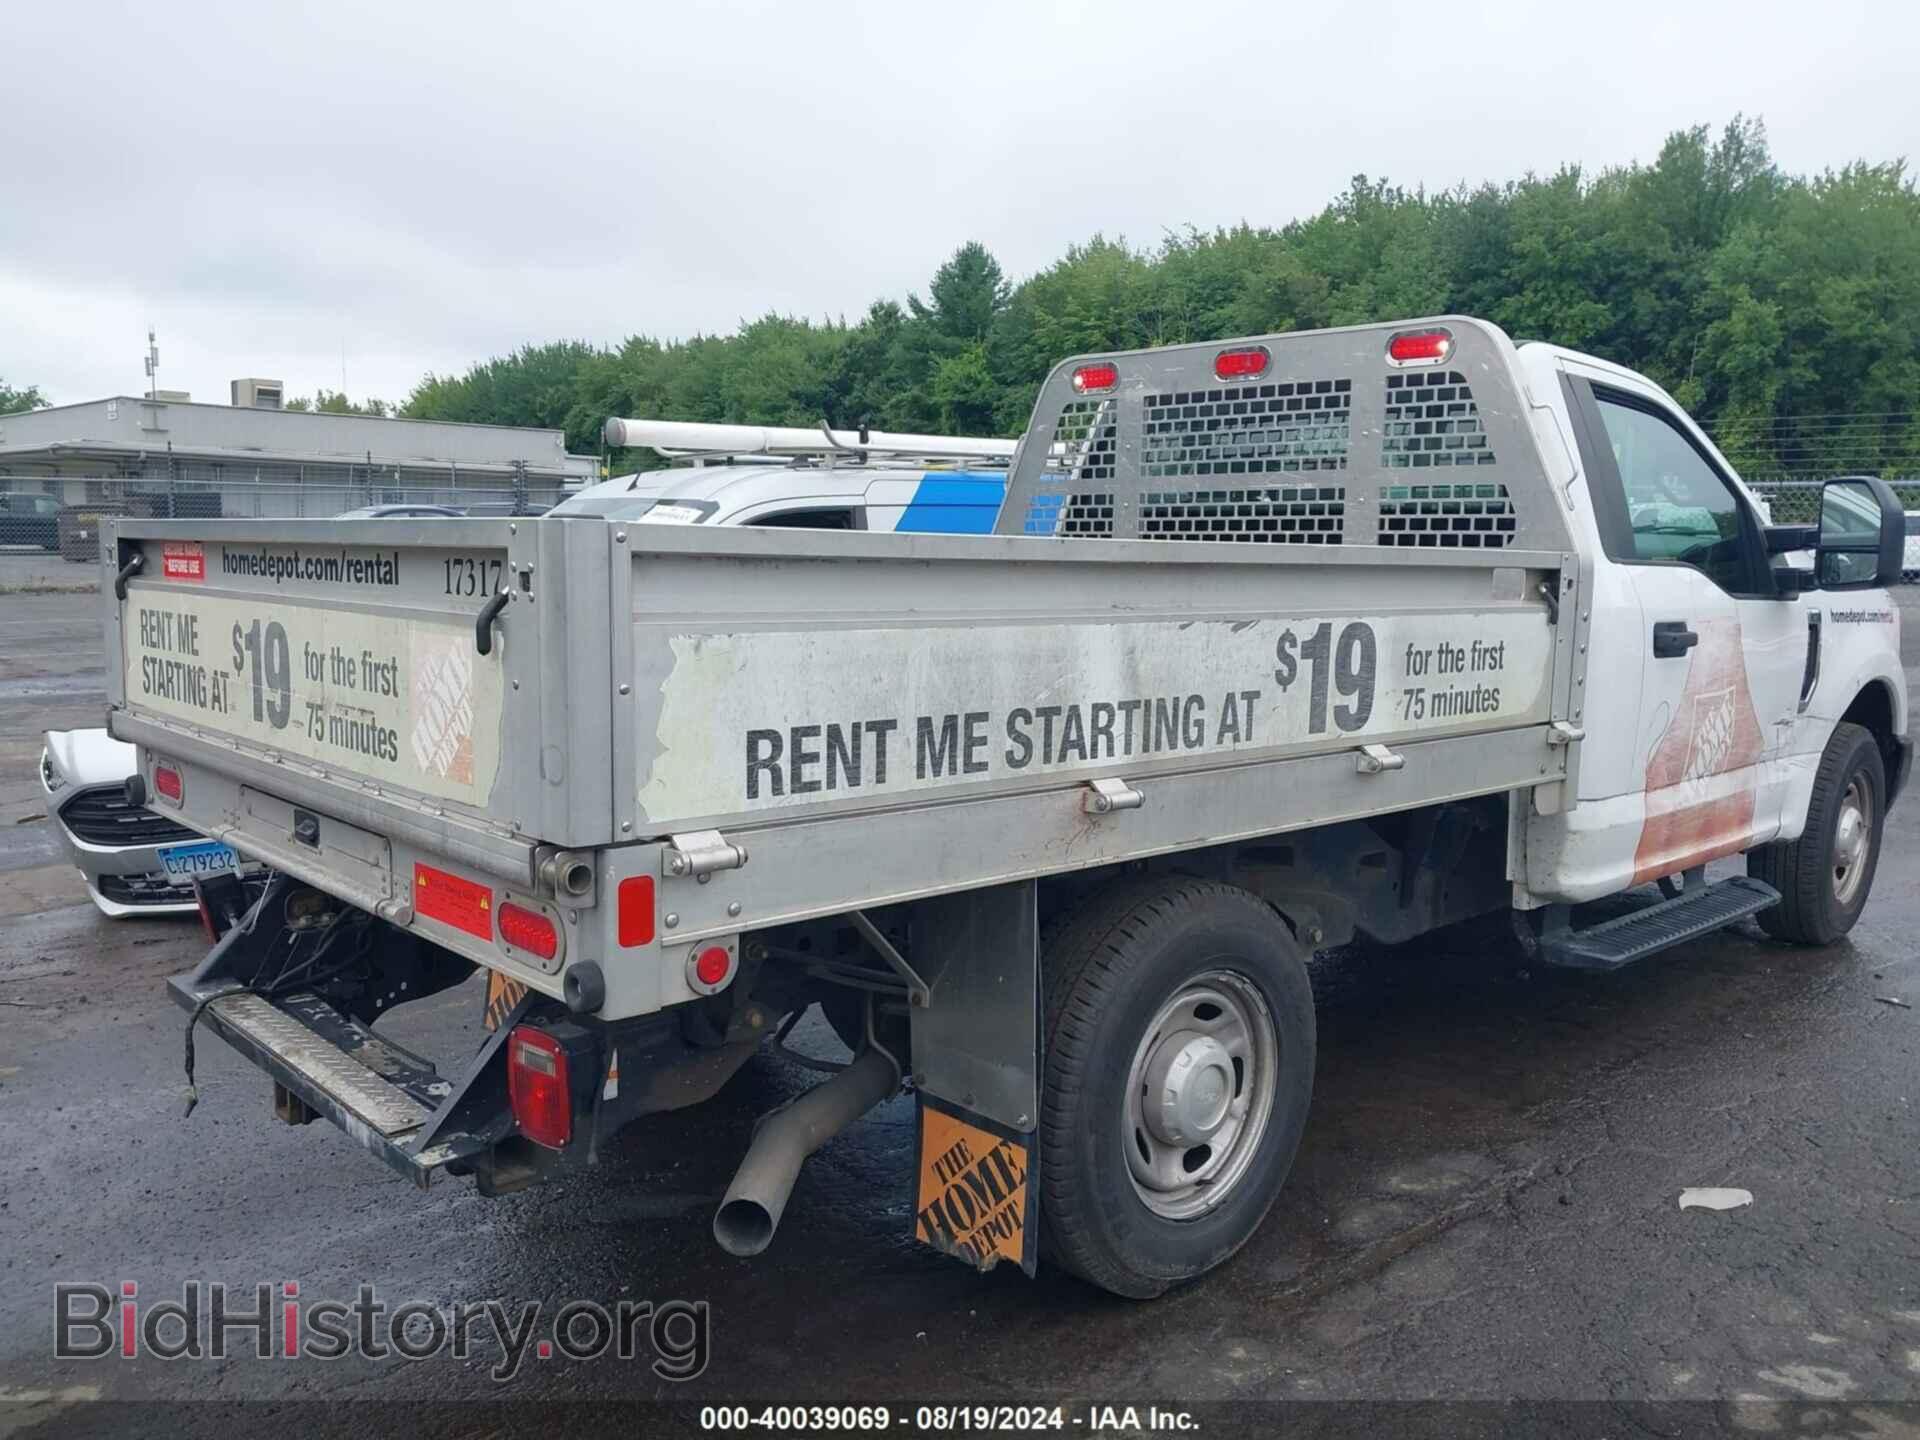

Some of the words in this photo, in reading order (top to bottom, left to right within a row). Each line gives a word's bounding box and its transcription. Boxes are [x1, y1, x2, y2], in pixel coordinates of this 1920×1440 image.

[222, 545, 399, 585] homedepot.com/rental
[444, 558, 502, 597] 17317
[140, 608, 173, 651] RENT
[177, 613, 199, 656] ME
[304, 641, 325, 683] for
[330, 646, 356, 689] the
[361, 650, 398, 698] first
[1405, 642, 1432, 676] for
[1438, 642, 1465, 674] the
[1471, 640, 1504, 671] first
[142, 655, 207, 708] STARTING
[212, 670, 229, 714] AT
[1404, 688, 1425, 720] 75
[1430, 683, 1500, 718] minutes
[306, 701, 325, 742] 75
[329, 709, 398, 762] minutes
[746, 719, 897, 799] RENT
[916, 712, 990, 780] ME
[1004, 694, 1206, 770] STARTING
[1216, 690, 1261, 745] AT
[931, 1137, 974, 1186] THE
[918, 1140, 1026, 1248] HOME
